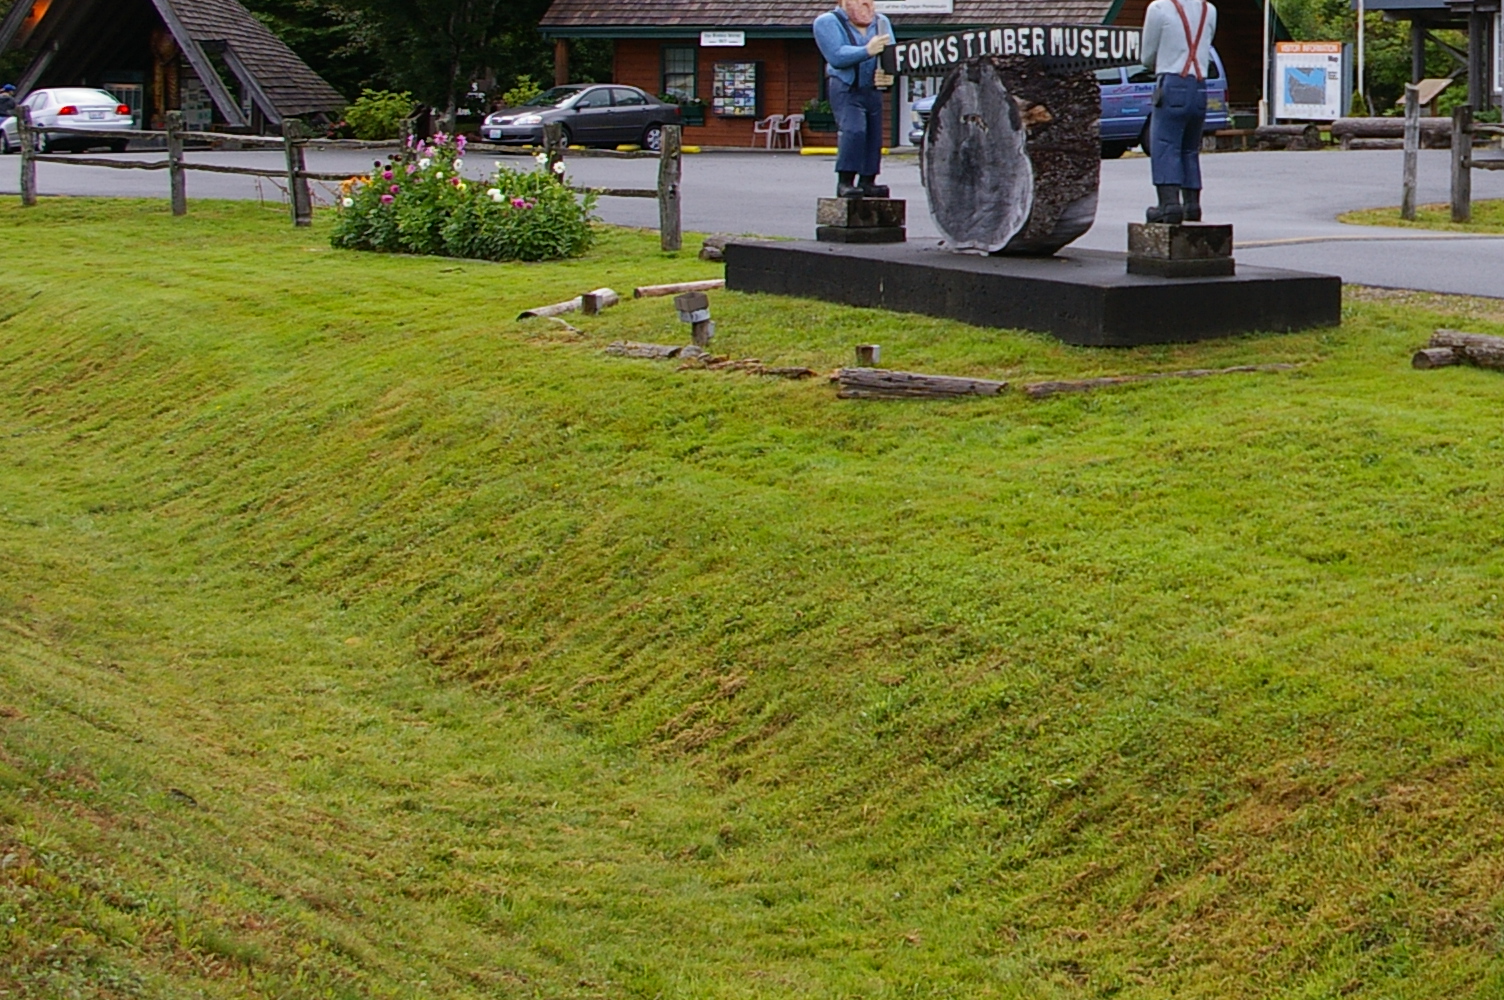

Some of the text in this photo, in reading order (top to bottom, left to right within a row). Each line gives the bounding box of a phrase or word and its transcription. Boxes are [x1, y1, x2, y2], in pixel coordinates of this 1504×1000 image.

[895, 27, 1140, 71] FORKS TIMBER MUSEUM
